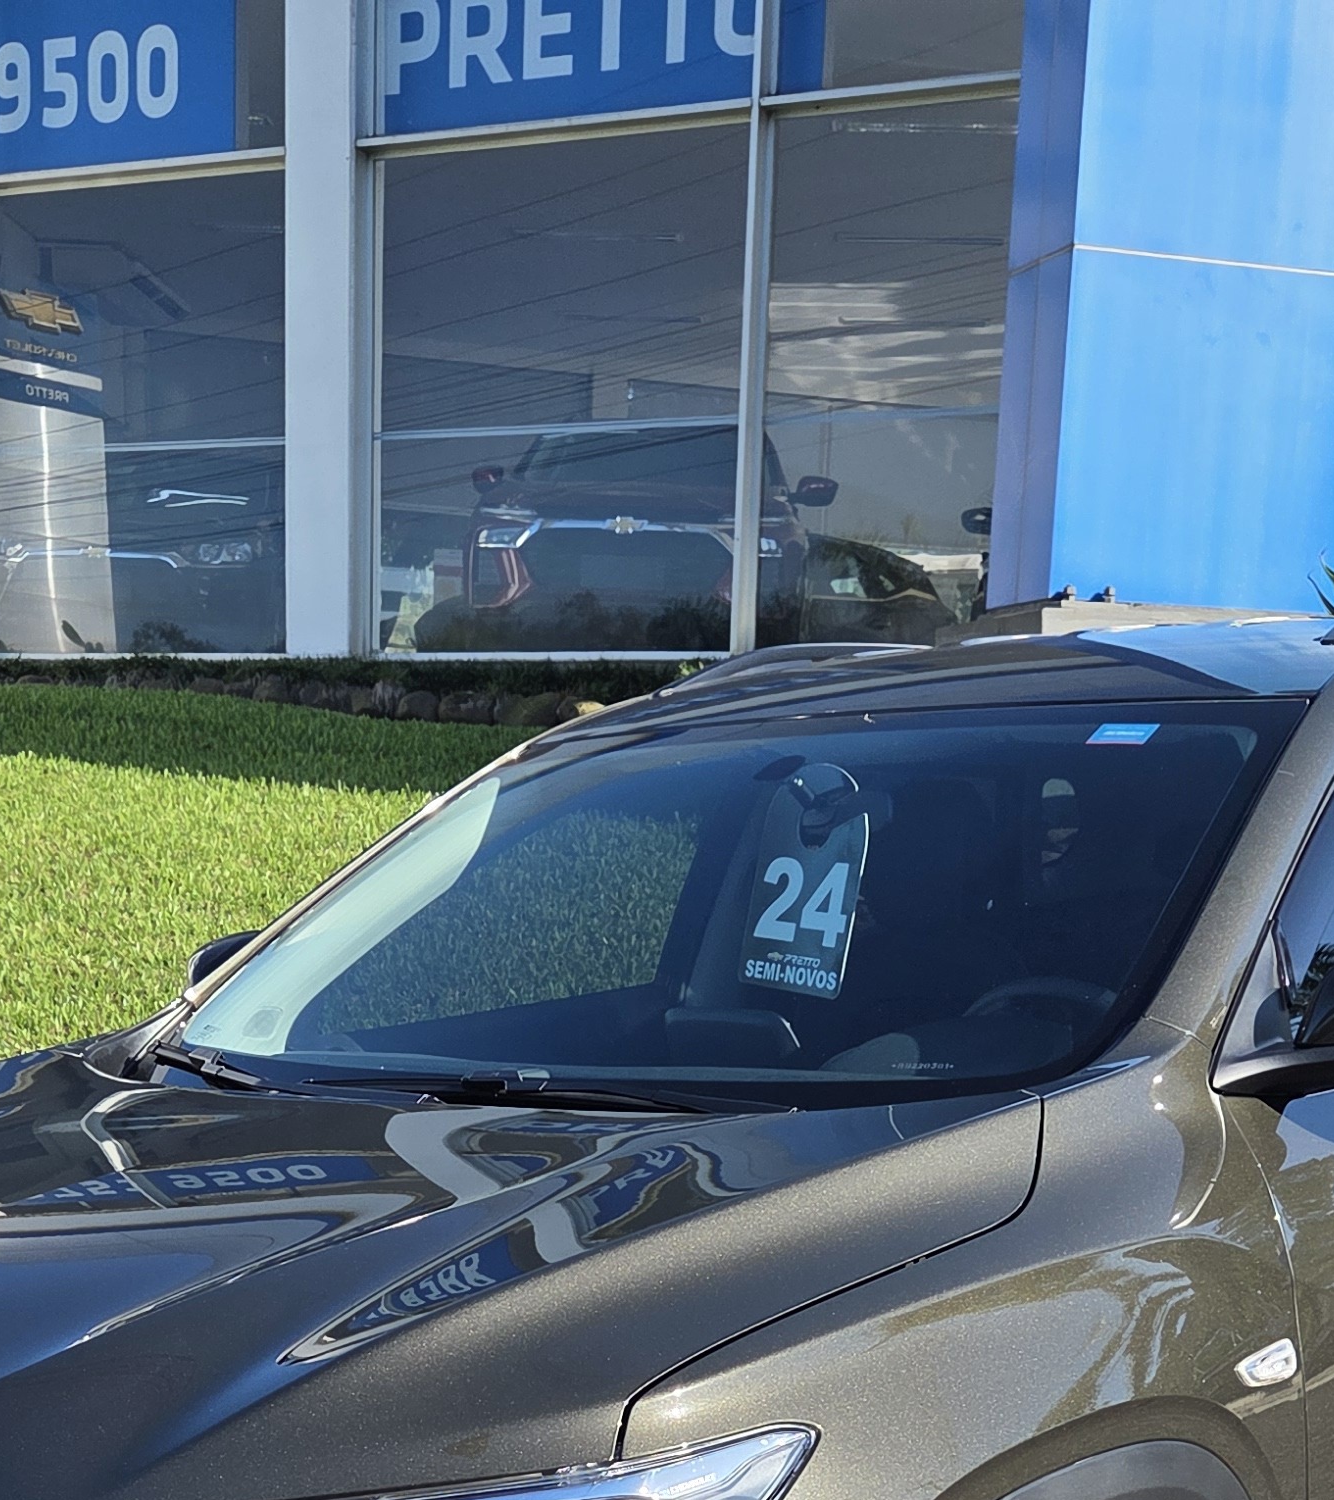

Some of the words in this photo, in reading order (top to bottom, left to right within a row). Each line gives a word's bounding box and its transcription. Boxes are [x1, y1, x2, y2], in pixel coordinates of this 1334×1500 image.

[753, 857, 849, 947] 24
[745, 959, 837, 991] SEMI-NOVOS
[784, 954, 820, 968] PRETTO
